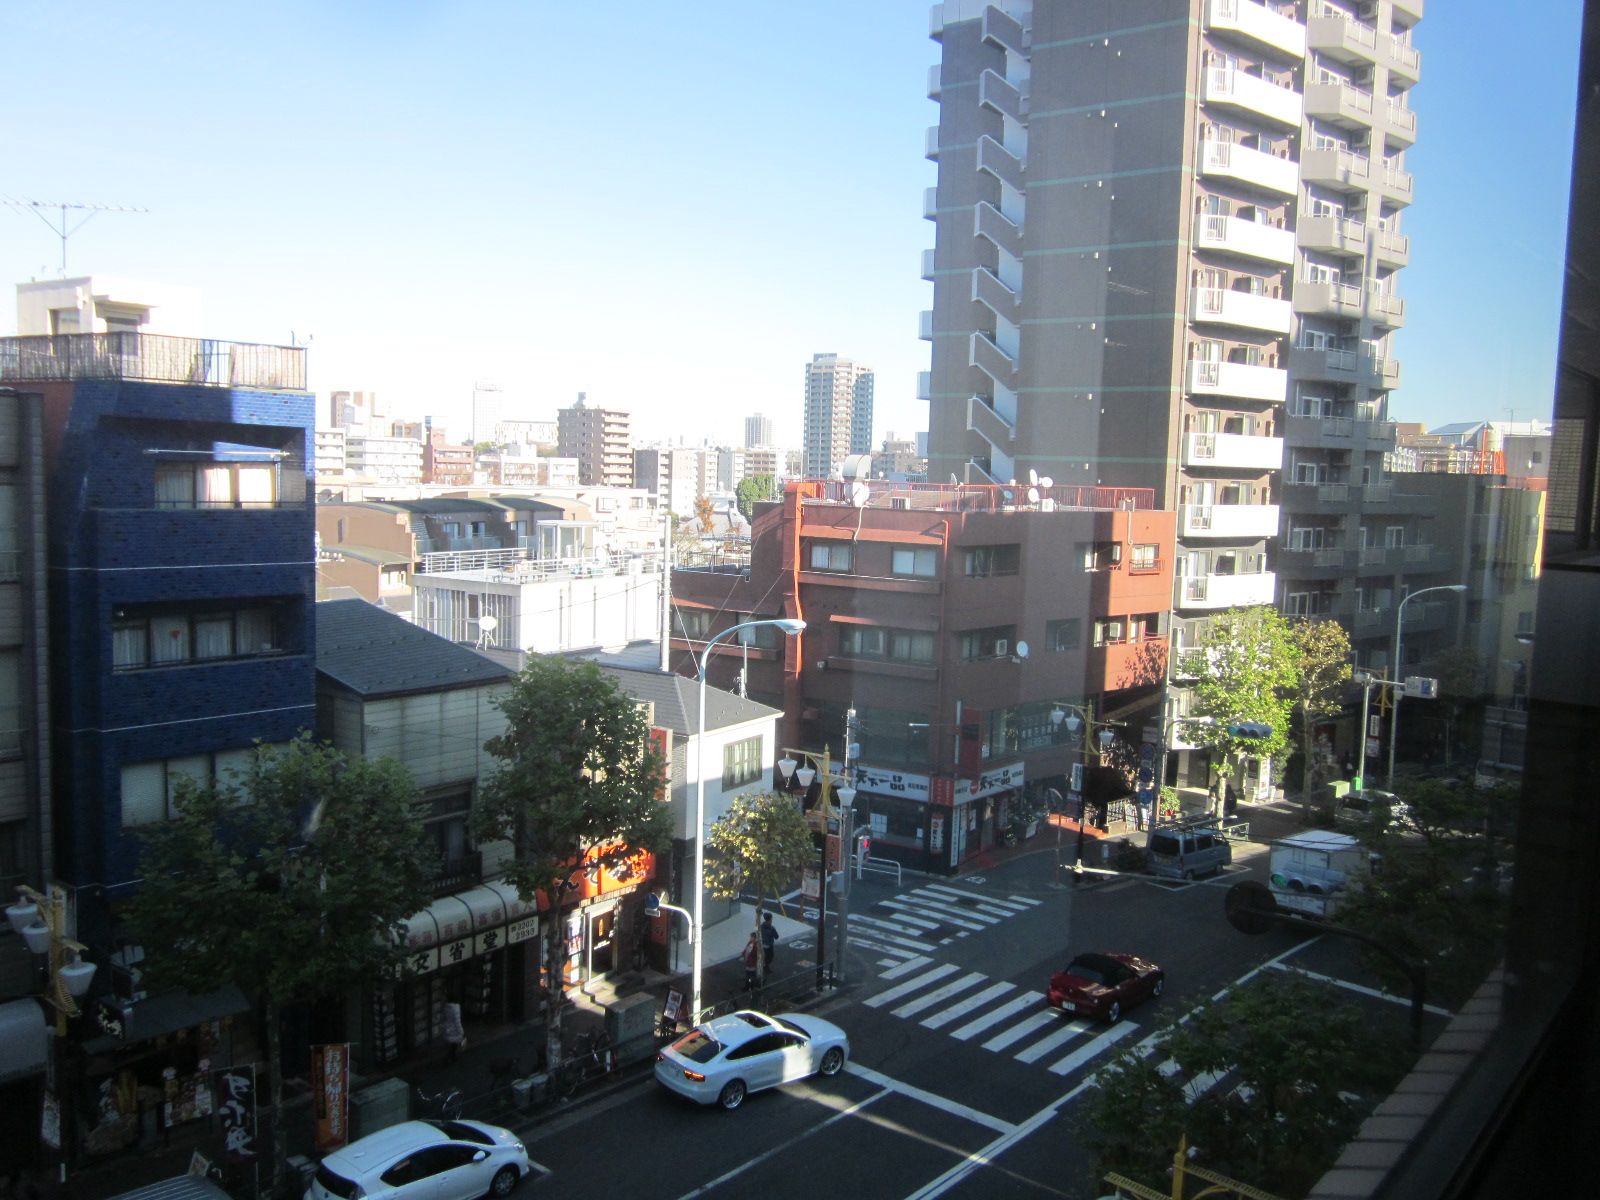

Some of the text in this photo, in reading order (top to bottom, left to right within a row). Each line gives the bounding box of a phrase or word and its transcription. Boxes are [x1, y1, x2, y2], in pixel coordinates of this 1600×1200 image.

[856, 769, 905, 791] 天下一品
[979, 769, 1011, 792] 天下一品
[412, 931, 498, 972] 文省堂
